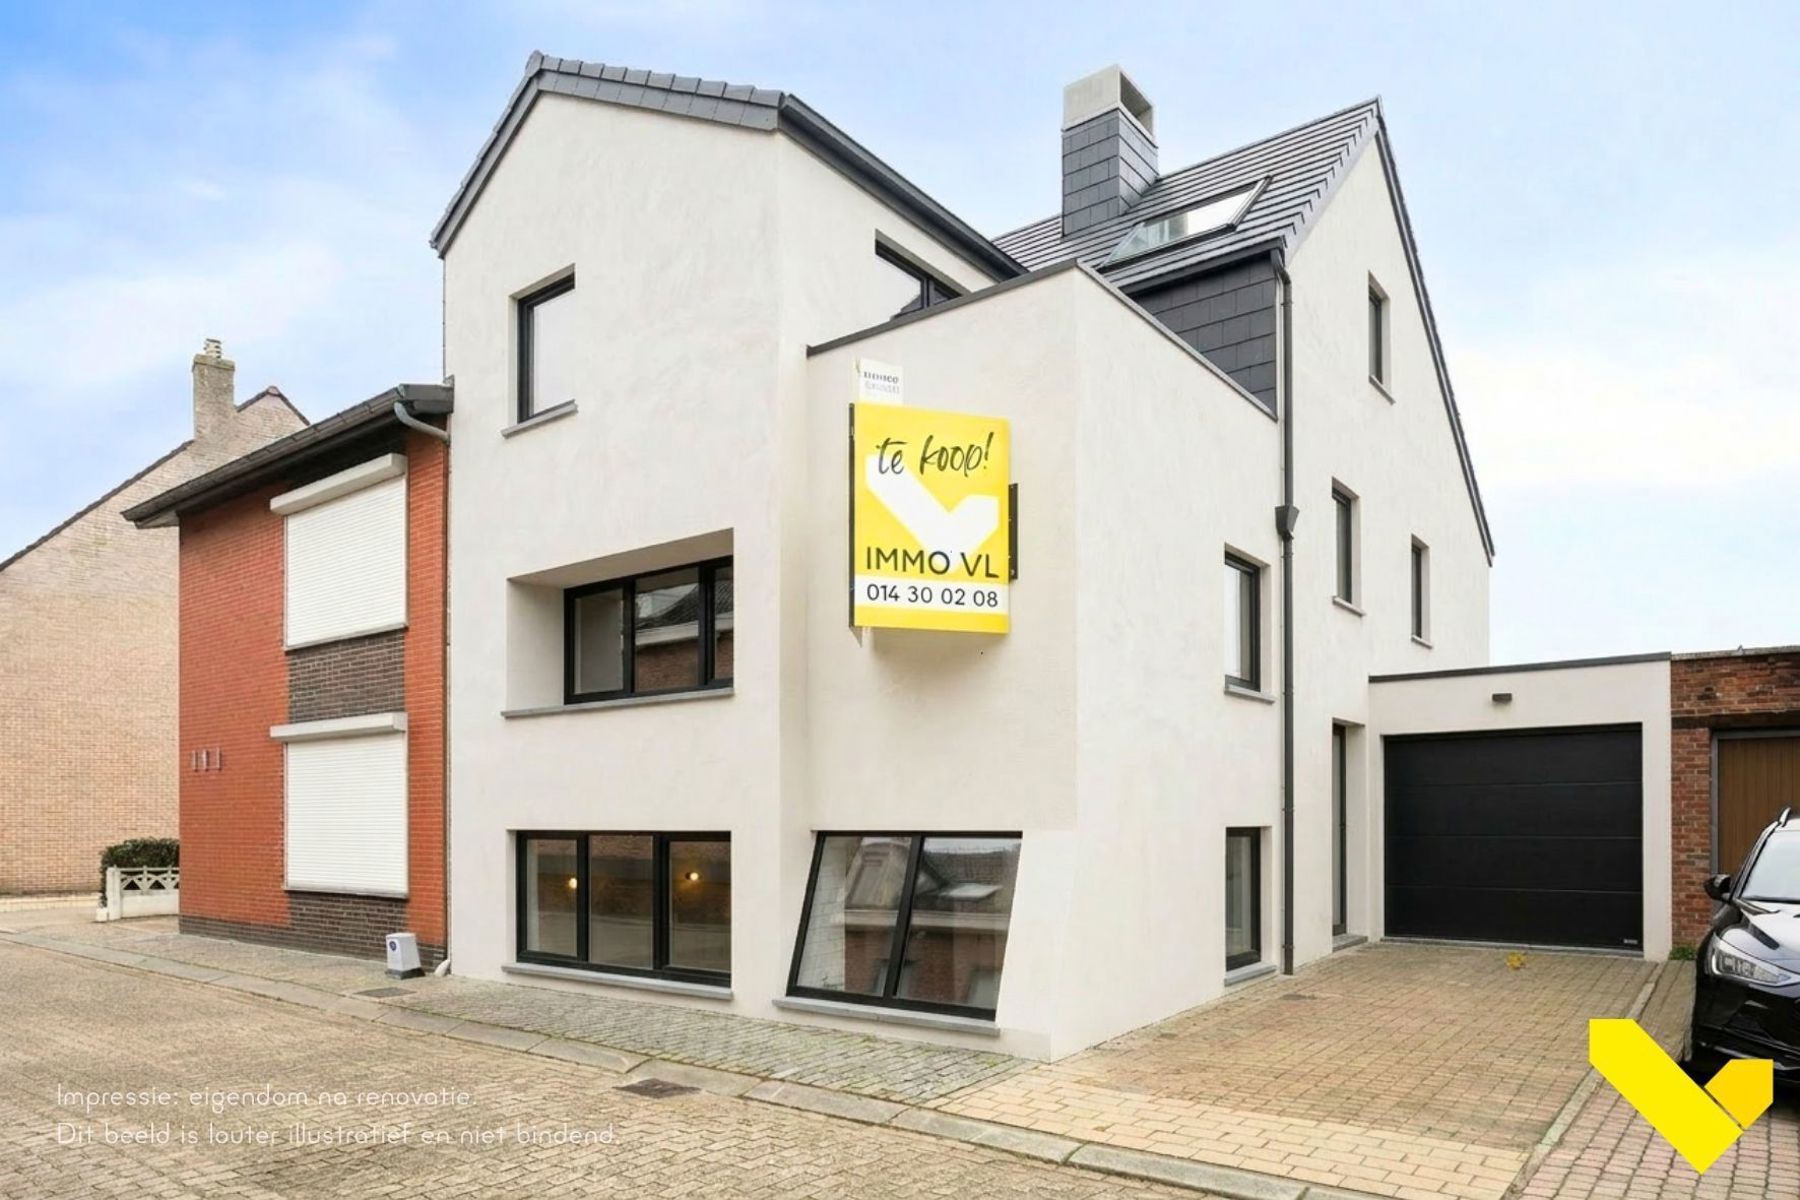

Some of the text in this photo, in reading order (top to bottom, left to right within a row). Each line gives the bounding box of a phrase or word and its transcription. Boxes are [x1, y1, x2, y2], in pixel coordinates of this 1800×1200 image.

[876, 431, 995, 477] te koop!
[866, 546, 1000, 579] IMMO VL
[866, 583, 999, 608] 014 30 02 08
